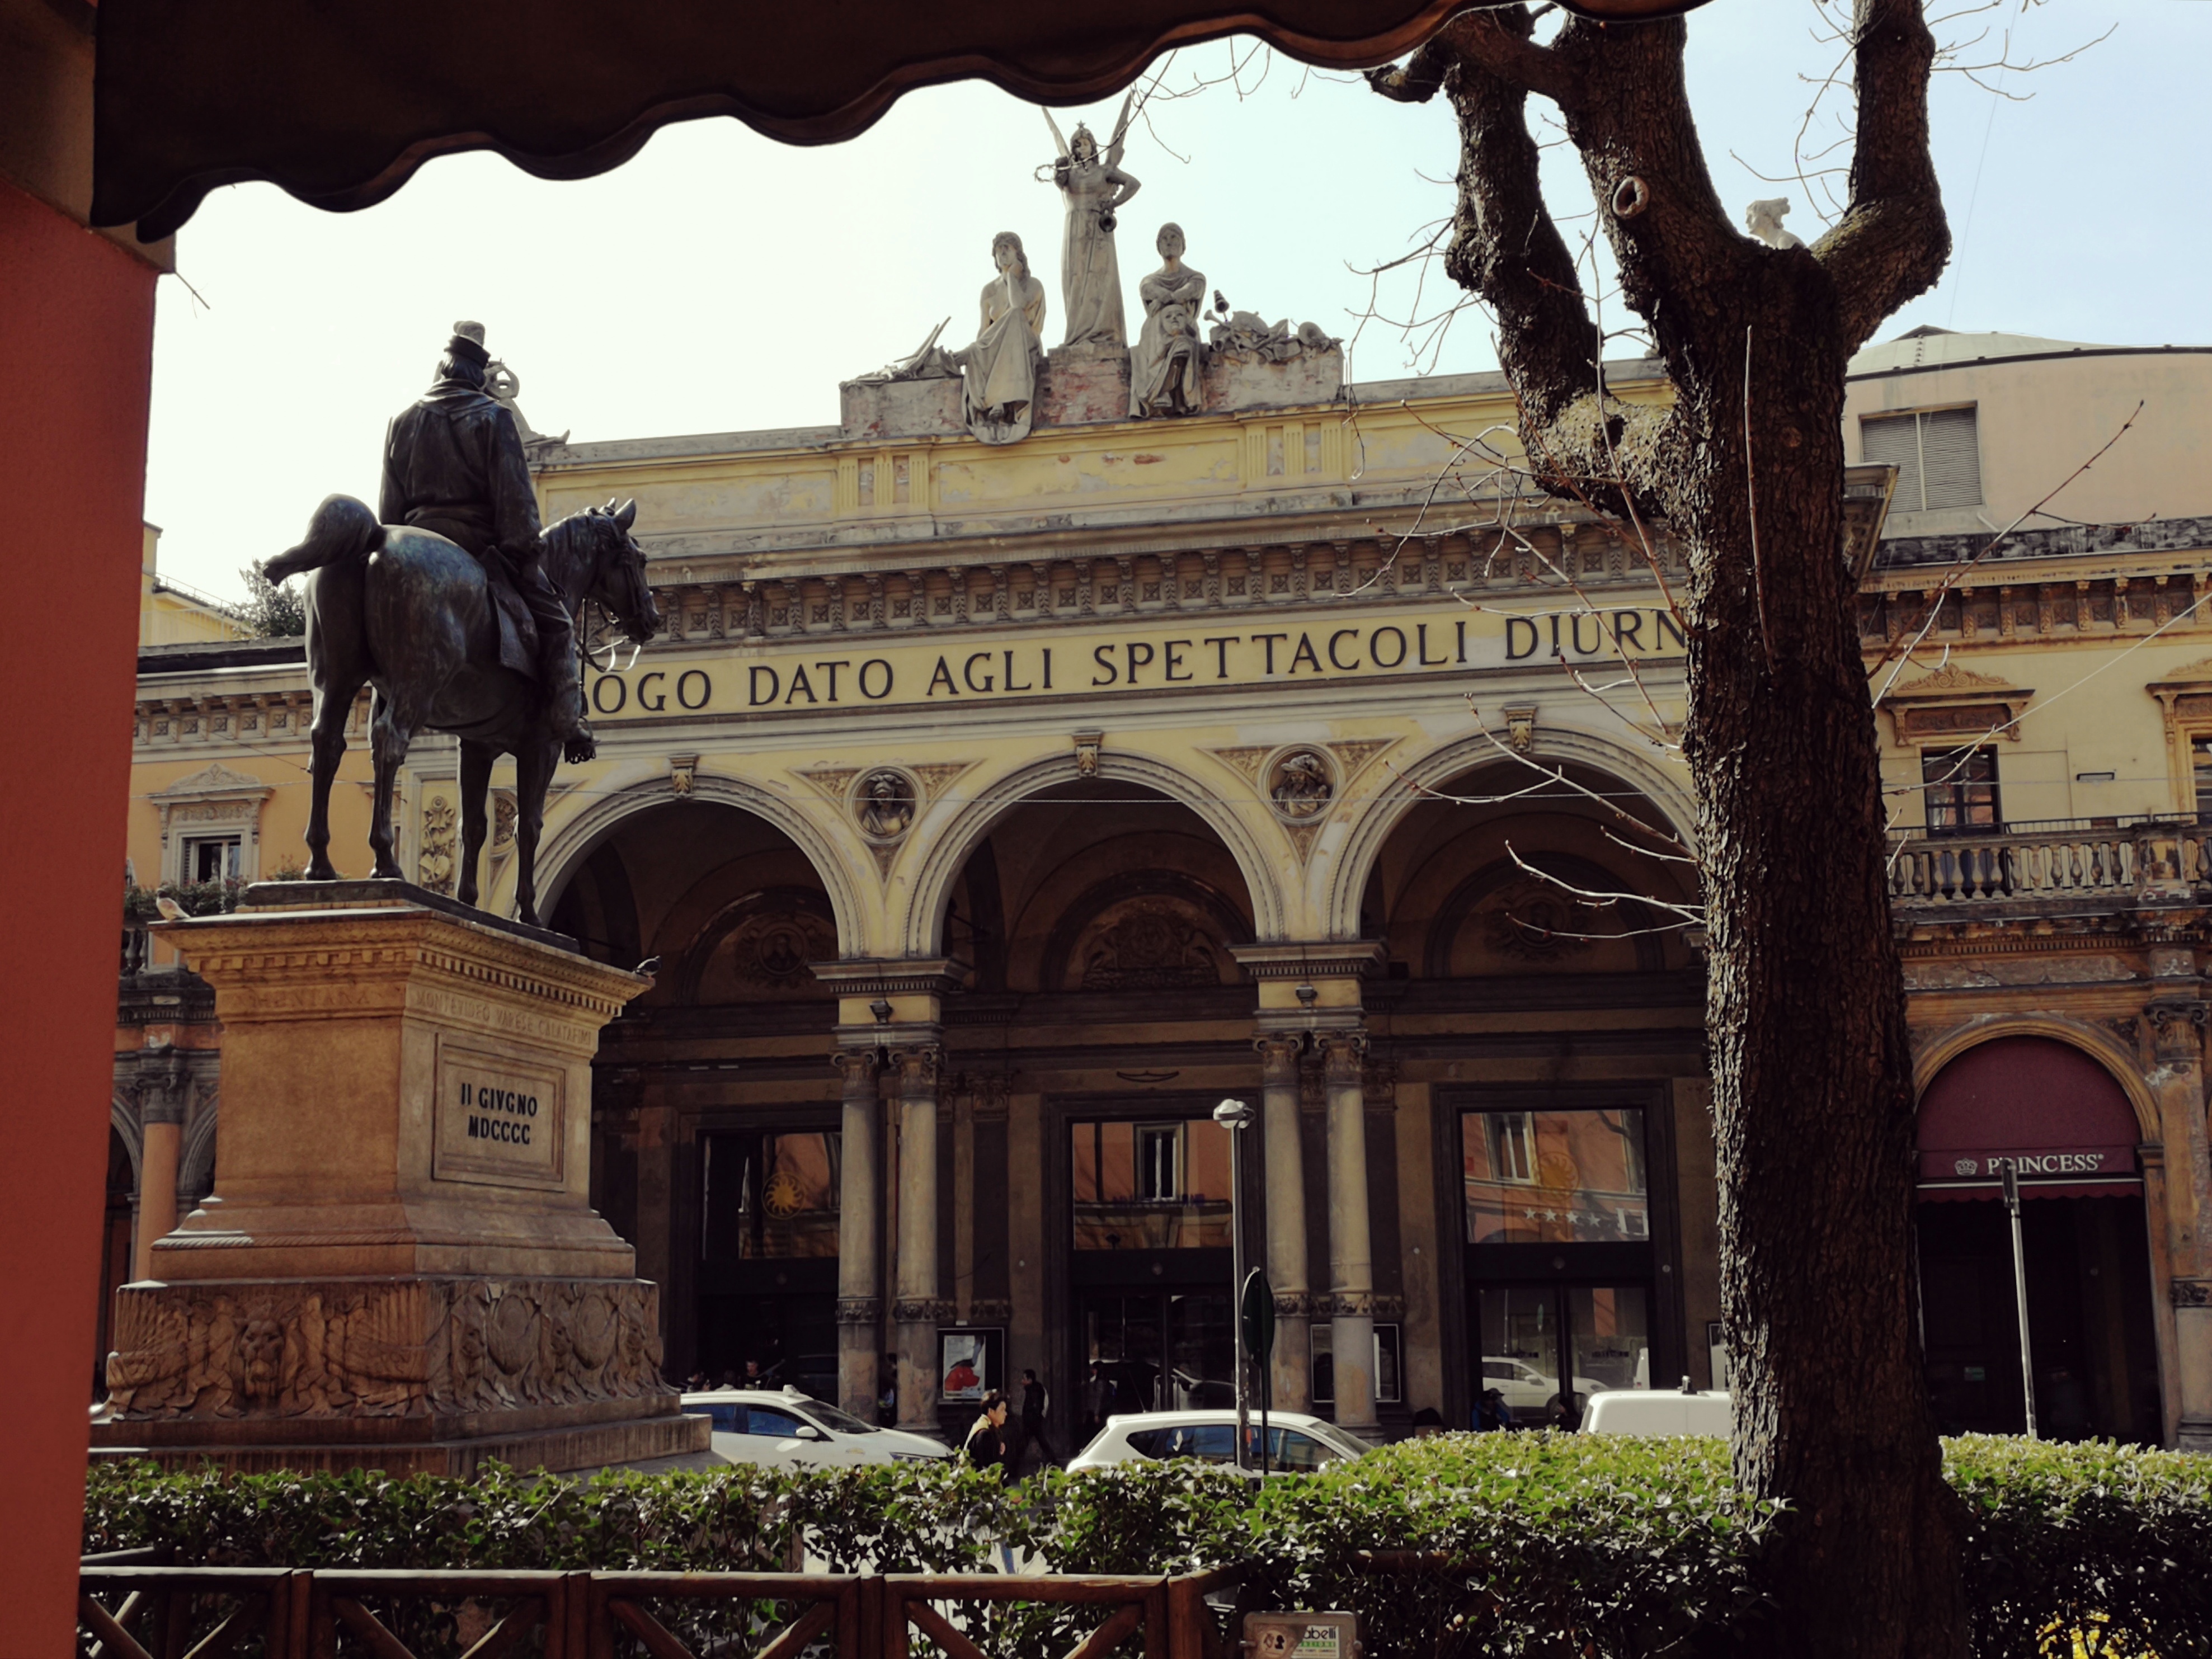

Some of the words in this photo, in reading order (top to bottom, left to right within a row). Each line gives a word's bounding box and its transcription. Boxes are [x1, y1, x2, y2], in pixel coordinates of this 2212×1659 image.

[592, 670, 712, 714] OGO
[749, 659, 894, 706] DATO
[926, 648, 1053, 696] AGLI
[1091, 621, 1466, 687] SPETTACOLI
[1505, 607, 1686, 660] DIURN
[479, 1087, 538, 1117] GIVGNO
[468, 1115, 530, 1144] MDCCCC
[1303, 1627, 1336, 1639] abelli
